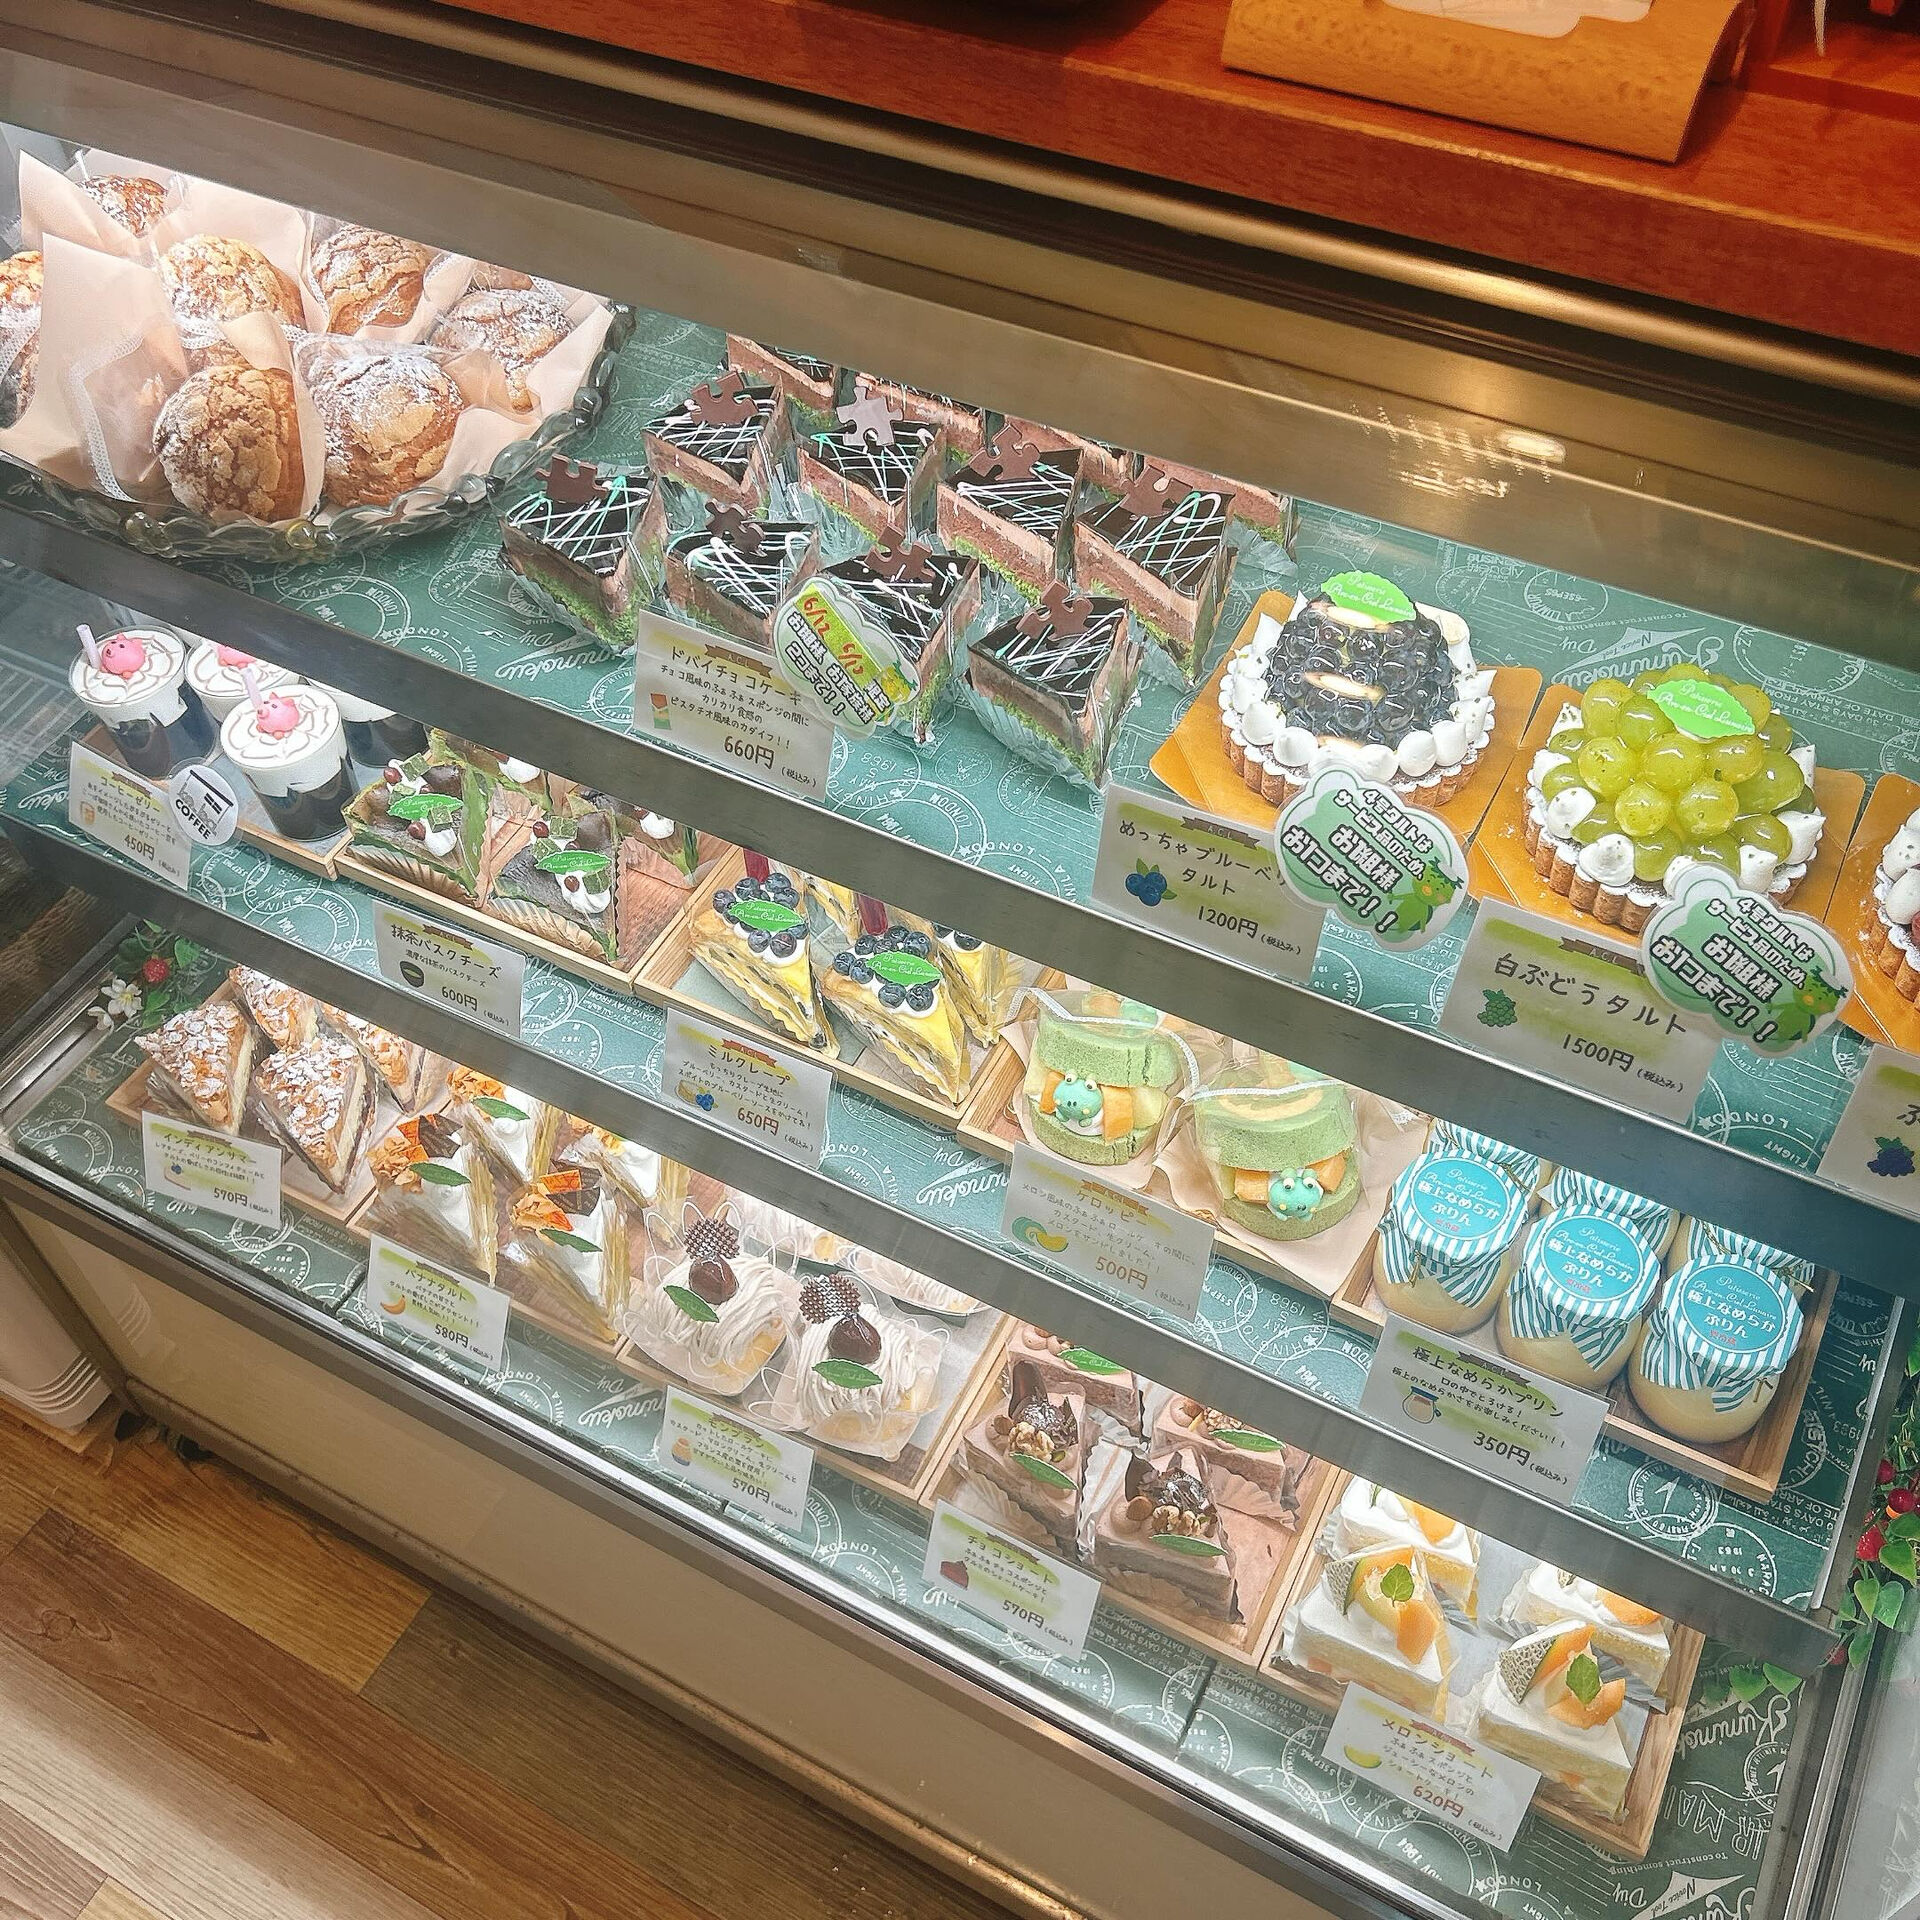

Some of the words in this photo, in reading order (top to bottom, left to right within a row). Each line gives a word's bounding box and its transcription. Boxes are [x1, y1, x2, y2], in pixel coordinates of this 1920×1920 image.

[671, 645, 803, 707] ドバイチョコケーキ
[701, 693, 762, 724] カリカリ食感の
[723, 732, 774, 770] 660円
[100, 775, 160, 816] コーヒーゼリー
[175, 799, 211, 840] COFFEE
[123, 830, 154, 862] 450円
[1181, 865, 1236, 898] タルト
[1198, 903, 1258, 940] 1200円
[390, 923, 502, 980] 抹茶バスクチーズ
[442, 984, 477, 1012] 600円
[1493, 949, 1689, 1041] 白ぶどうタルト
[707, 1043, 790, 1089] ミルクレープ
[1562, 1029, 1634, 1076] 1500円
[737, 1103, 779, 1137] 650円
[163, 1132, 256, 1166] インディアンサマー
[214, 1186, 247, 1207] 570円
[1076, 1189, 1148, 1231] ケロッピー
[1418, 1181, 1500, 1220] 極上なめらか
[1095, 1253, 1148, 1291] 500円
[1548, 1238, 1632, 1283] 極上なめらか
[405, 1266, 467, 1302] バナナタルト
[1687, 1289, 1775, 1332] 極上なめらか
[434, 1321, 468, 1348] 580円
[1411, 1345, 1566, 1420] 極上なめらかプリン
[1440, 1376, 1522, 1418] 口の中でとろける！
[708, 1417, 764, 1450] モンブラン
[1472, 1427, 1530, 1468] 350円
[731, 1476, 769, 1504] 570円
[967, 1533, 1054, 1586] チョコショート
[1002, 1597, 1044, 1629] 570円
[1381, 1717, 1495, 1781] メロンショート
[1412, 1782, 1464, 1819] 620円
[1609, 1861, 1663, 1876] something
[1665, 1854, 1713, 1867] construct
[1715, 1852, 1728, 1861] To
[1612, 1882, 1647, 1909] Diy
[1651, 1898, 1668, 1915] Tool
[1668, 1879, 1695, 1902] Novice
